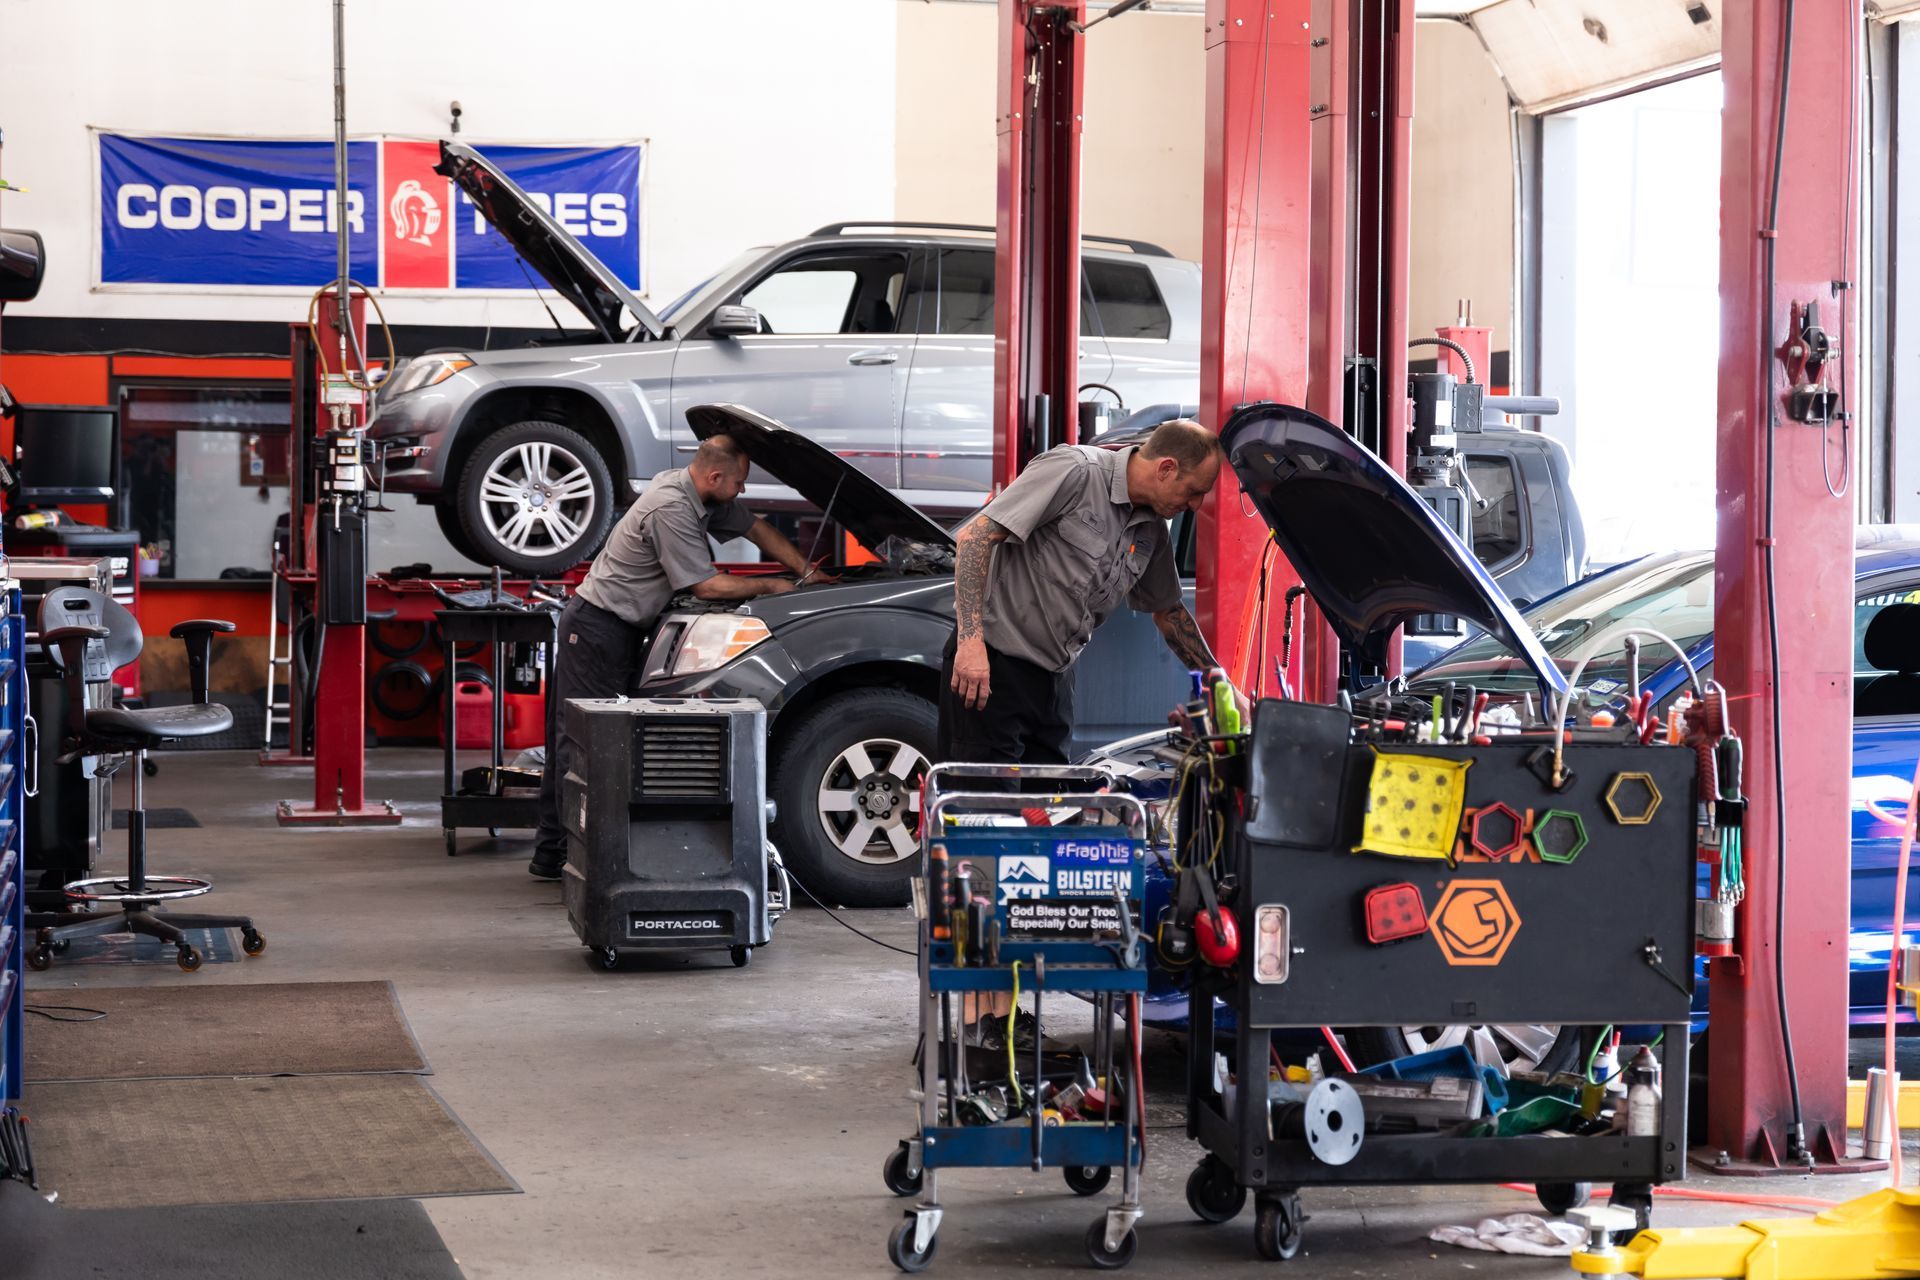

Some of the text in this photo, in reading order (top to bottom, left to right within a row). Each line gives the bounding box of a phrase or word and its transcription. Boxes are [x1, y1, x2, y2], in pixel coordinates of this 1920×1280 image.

[117, 183, 365, 233] COOPER
[1056, 841, 1130, 861] #FragThis
[1056, 870, 1132, 890] BILSTEIN
[1058, 889, 1085, 897] SHOCK
[1010, 905, 1034, 917] God
[1036, 905, 1066, 917] Bless
[1069, 905, 1090, 917] Our
[634, 920, 722, 929] PORTACOOL
[1010, 918, 1066, 931] Especially
[1067, 918, 1089, 929] Our
